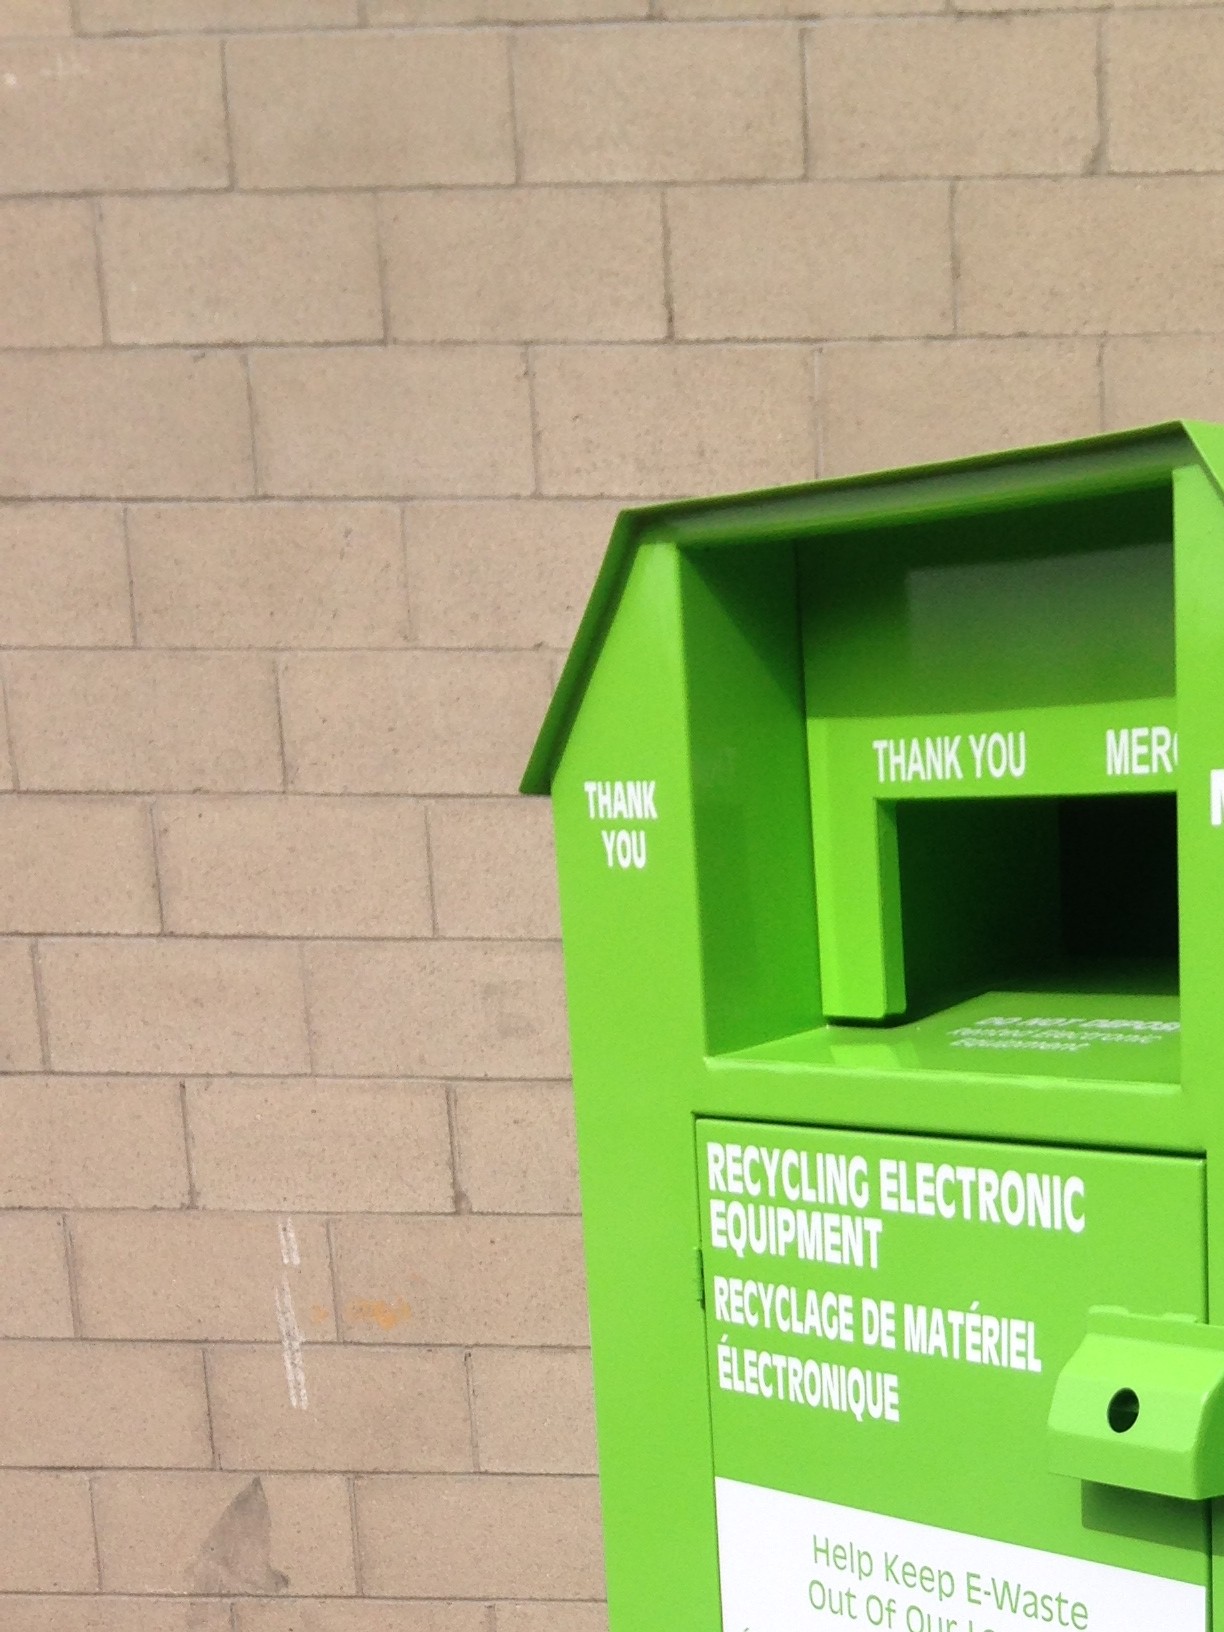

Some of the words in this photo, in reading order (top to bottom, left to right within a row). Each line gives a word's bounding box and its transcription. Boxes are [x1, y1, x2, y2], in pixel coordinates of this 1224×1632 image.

[873, 735, 963, 783] THANK
[969, 731, 1026, 779] YOU
[584, 780, 658, 820] THANK
[601, 829, 646, 869] YOU
[707, 1142, 869, 1208] RECYCLING
[880, 1158, 1085, 1233] ELECTRONIC
[710, 1200, 882, 1269] EQUIPMENT
[714, 1276, 853, 1342] RECYCLAGE
[862, 1297, 895, 1348] DE
[904, 1302, 1041, 1372] MATÉRIEL
[717, 1334, 899, 1422] ÉLECTRONIQUE
[809, 1580, 856, 1620] Out
[866, 1594, 895, 1628] Of
[813, 1534, 873, 1579] Help
[884, 1551, 955, 1600] Keep
[966, 1572, 1089, 1629] E-Waste
